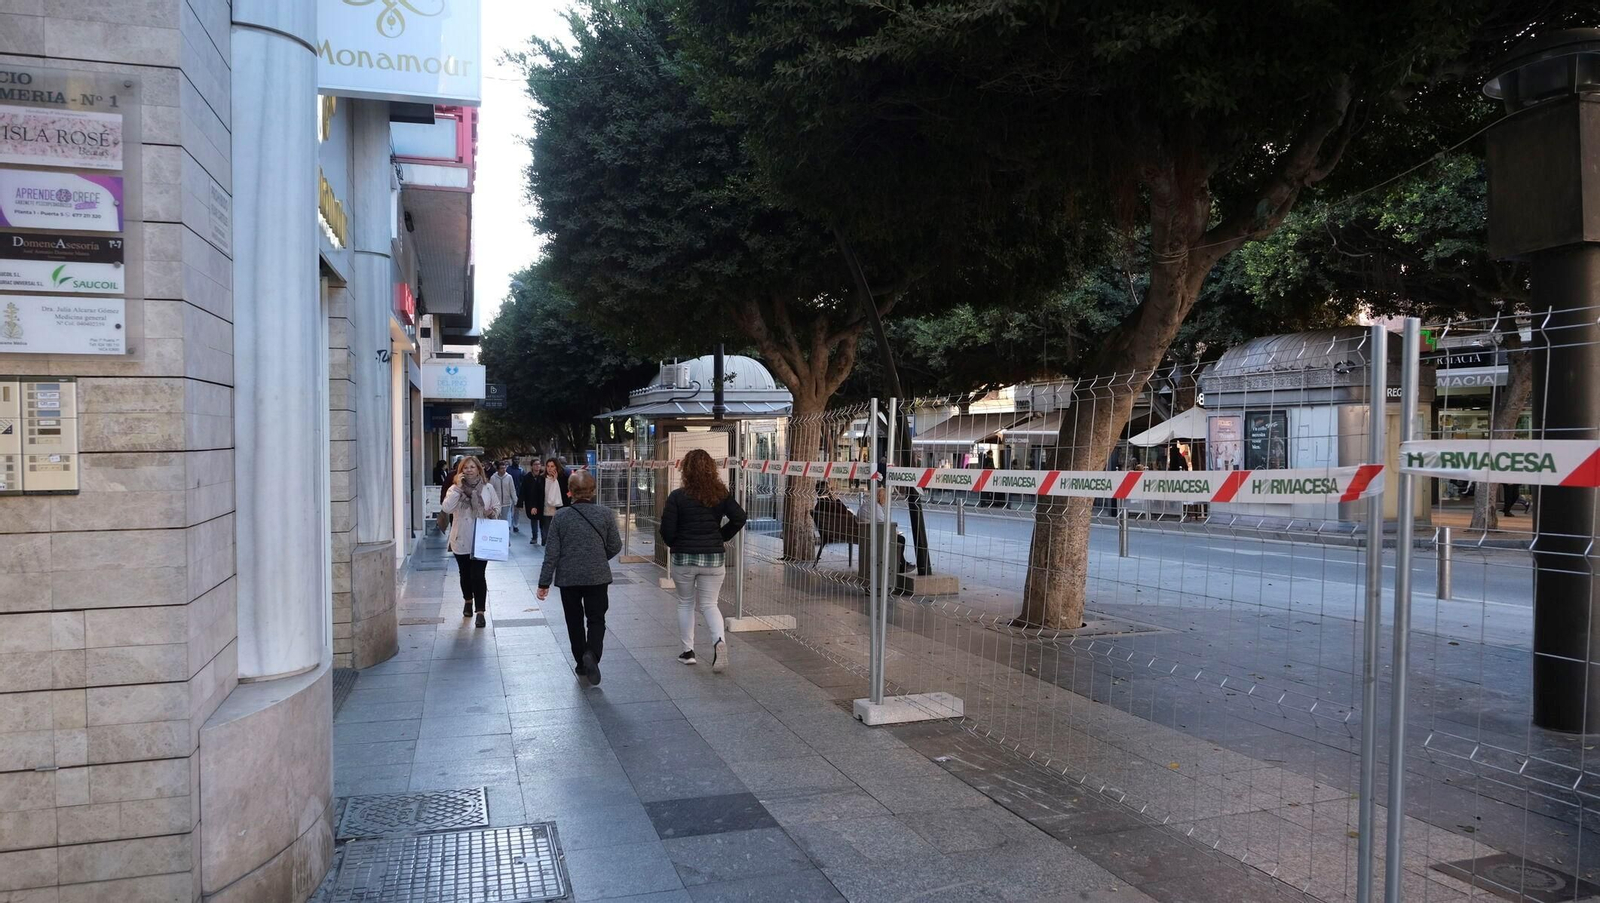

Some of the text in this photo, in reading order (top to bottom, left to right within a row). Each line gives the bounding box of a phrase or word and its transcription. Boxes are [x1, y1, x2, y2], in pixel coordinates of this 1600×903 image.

[317, 39, 472, 77] Monamour
[0, 71, 32, 85] CIO
[109, 95, 119, 107] 1
[3, 125, 111, 147] ISLA ROSÉ
[15, 187, 56, 201] APRENDE
[72, 191, 101, 204] CRECE
[73, 280, 119, 290] SAUCOIL
